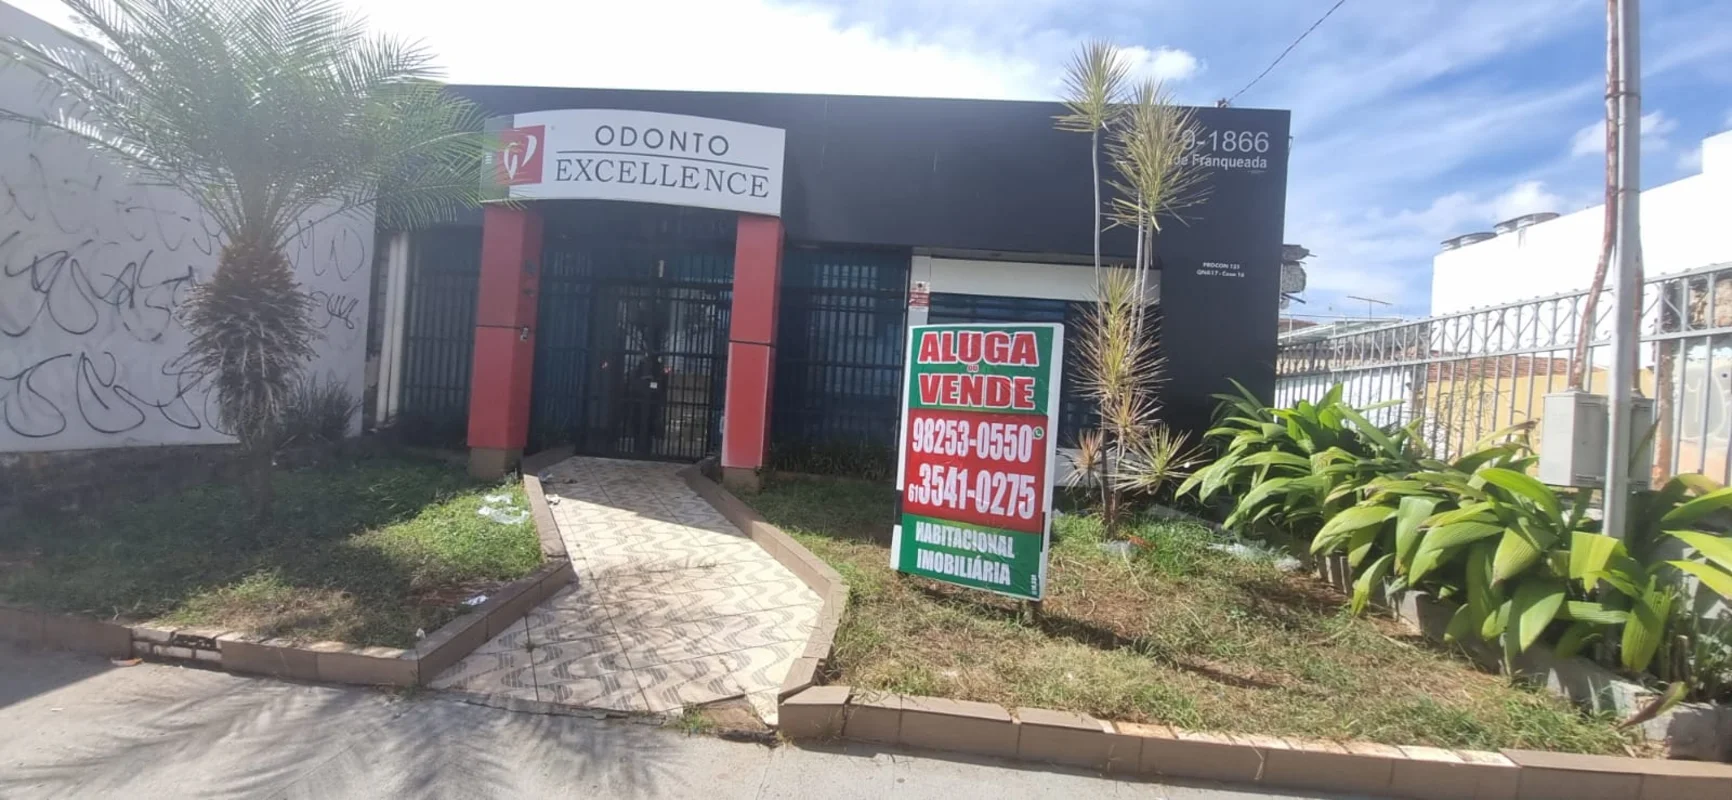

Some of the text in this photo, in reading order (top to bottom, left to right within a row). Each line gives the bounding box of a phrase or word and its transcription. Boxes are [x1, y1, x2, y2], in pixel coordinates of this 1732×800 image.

[595, 125, 729, 156] ODONTO
[554, 159, 769, 198] EXCELLENCE
[1192, 153, 1268, 170] Franqueada
[918, 331, 1039, 367] ALUGA
[918, 373, 1035, 410] VENDE
[912, 417, 1033, 463] 98253-0550
[908, 463, 1036, 519] 61 3541-0275
[915, 521, 1015, 559] HABITACIONAL
[916, 548, 1011, 586] IMOBILIÁRIA
